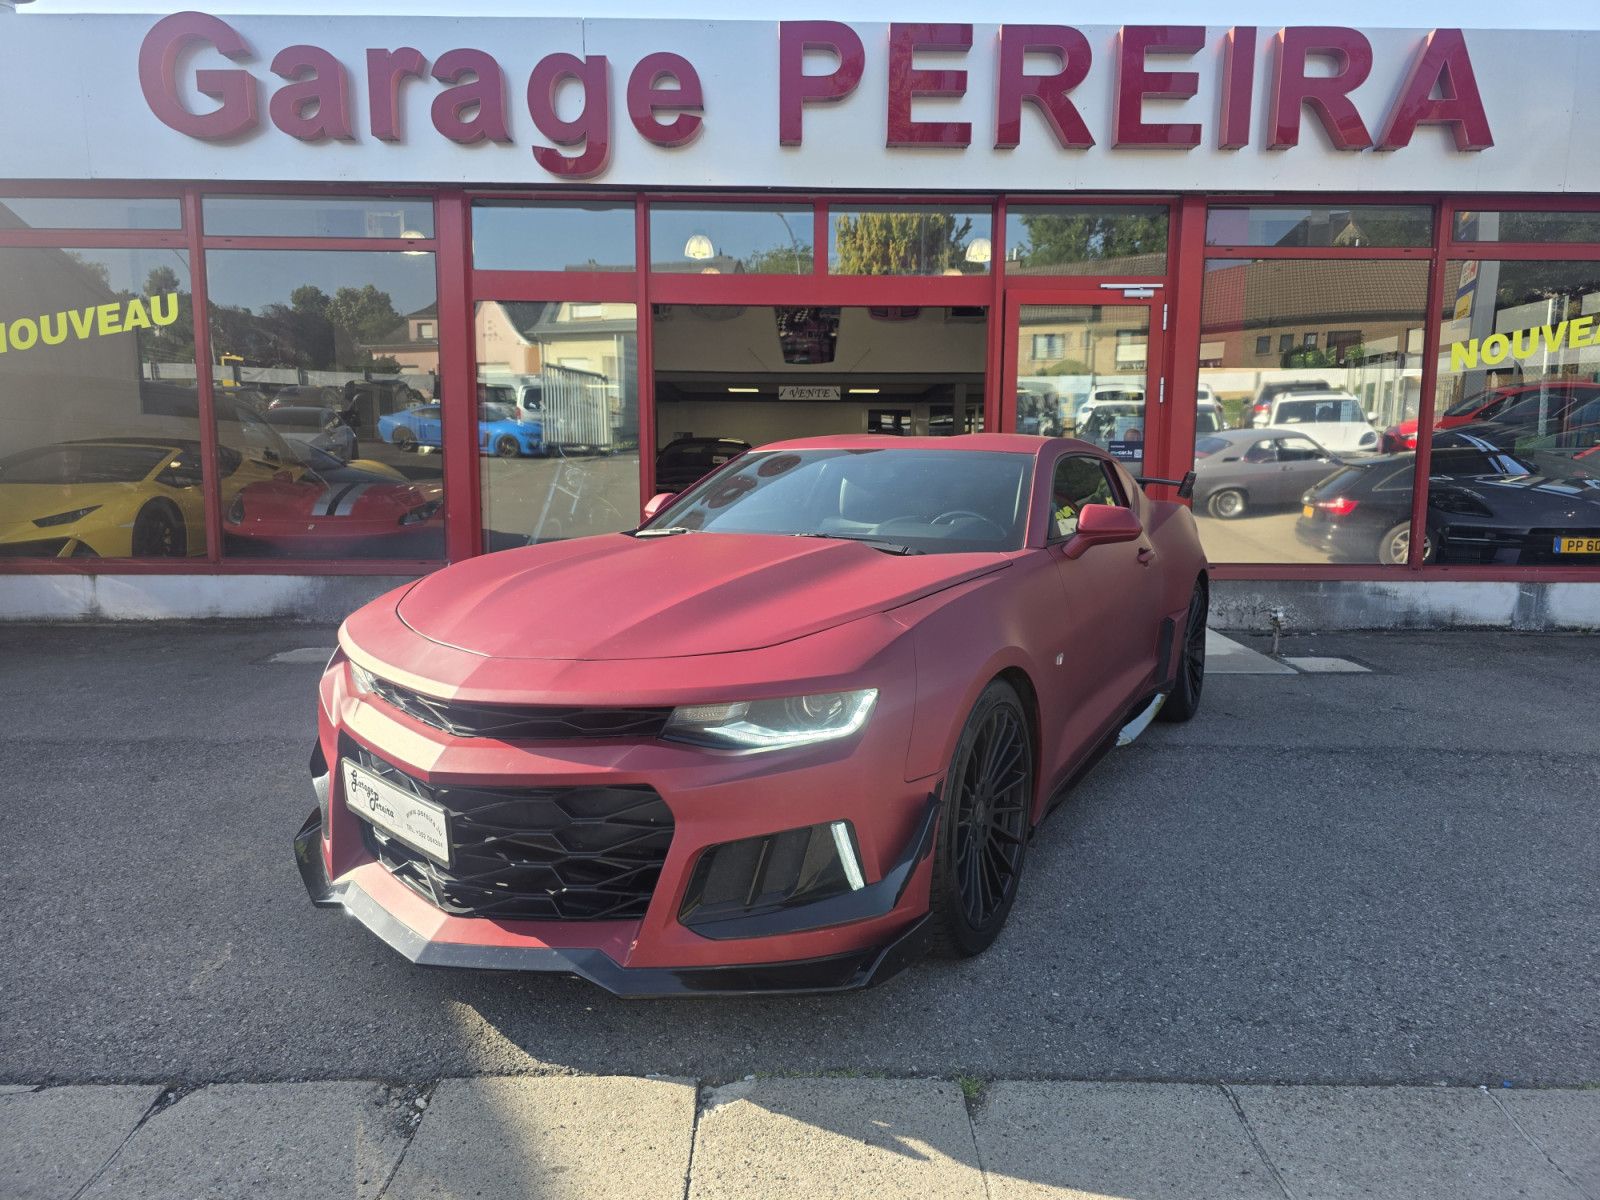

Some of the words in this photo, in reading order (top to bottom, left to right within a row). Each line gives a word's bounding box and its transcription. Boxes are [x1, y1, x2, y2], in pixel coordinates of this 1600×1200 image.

[138, 11, 705, 180] Garage
[779, 21, 1494, 152] PEREIRA
[0, 293, 179, 354] OUVEAU
[1451, 316, 1600, 372] NOUVE
[789, 387, 831, 398] VENTE
[1567, 540, 1584, 551] PP
